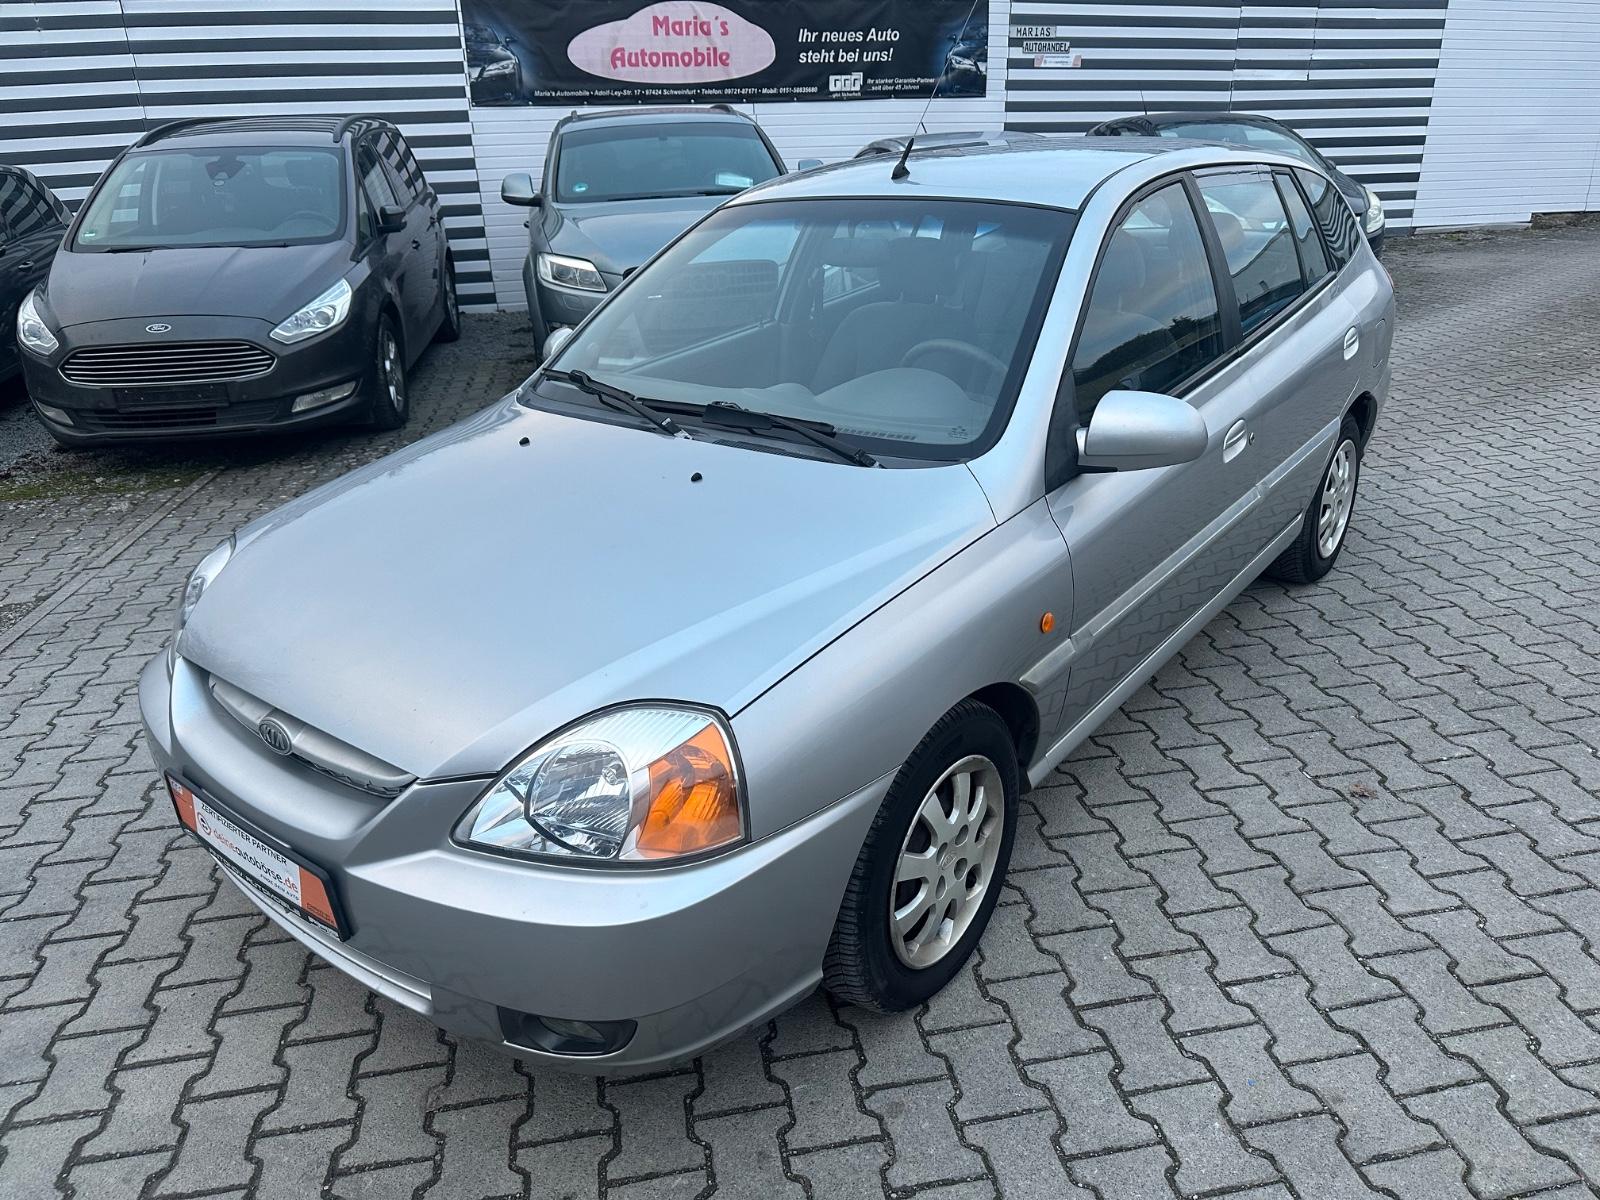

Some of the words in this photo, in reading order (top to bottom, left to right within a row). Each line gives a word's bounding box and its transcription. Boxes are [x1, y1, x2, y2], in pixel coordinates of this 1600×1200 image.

[798, 28, 818, 42] Ihr
[821, 29, 863, 42] neues
[866, 28, 900, 42] Auto
[1016, 27, 1051, 37] MARIAS
[798, 49, 834, 63] steht
[838, 48, 859, 62] bei
[863, 47, 894, 62] uns!
[1024, 42, 1069, 52] AUTOHANDEL
[610, 47, 730, 70] Automobile
[556, 89, 590, 97] Automobile
[663, 88, 696, 96] Schweinfurt
[260, 724, 286, 750] KIA
[201, 802, 252, 845] ZERTIFIZIERTER
[252, 840, 288, 867] PARTNER
[213, 828, 300, 894] deineautobörse.de
